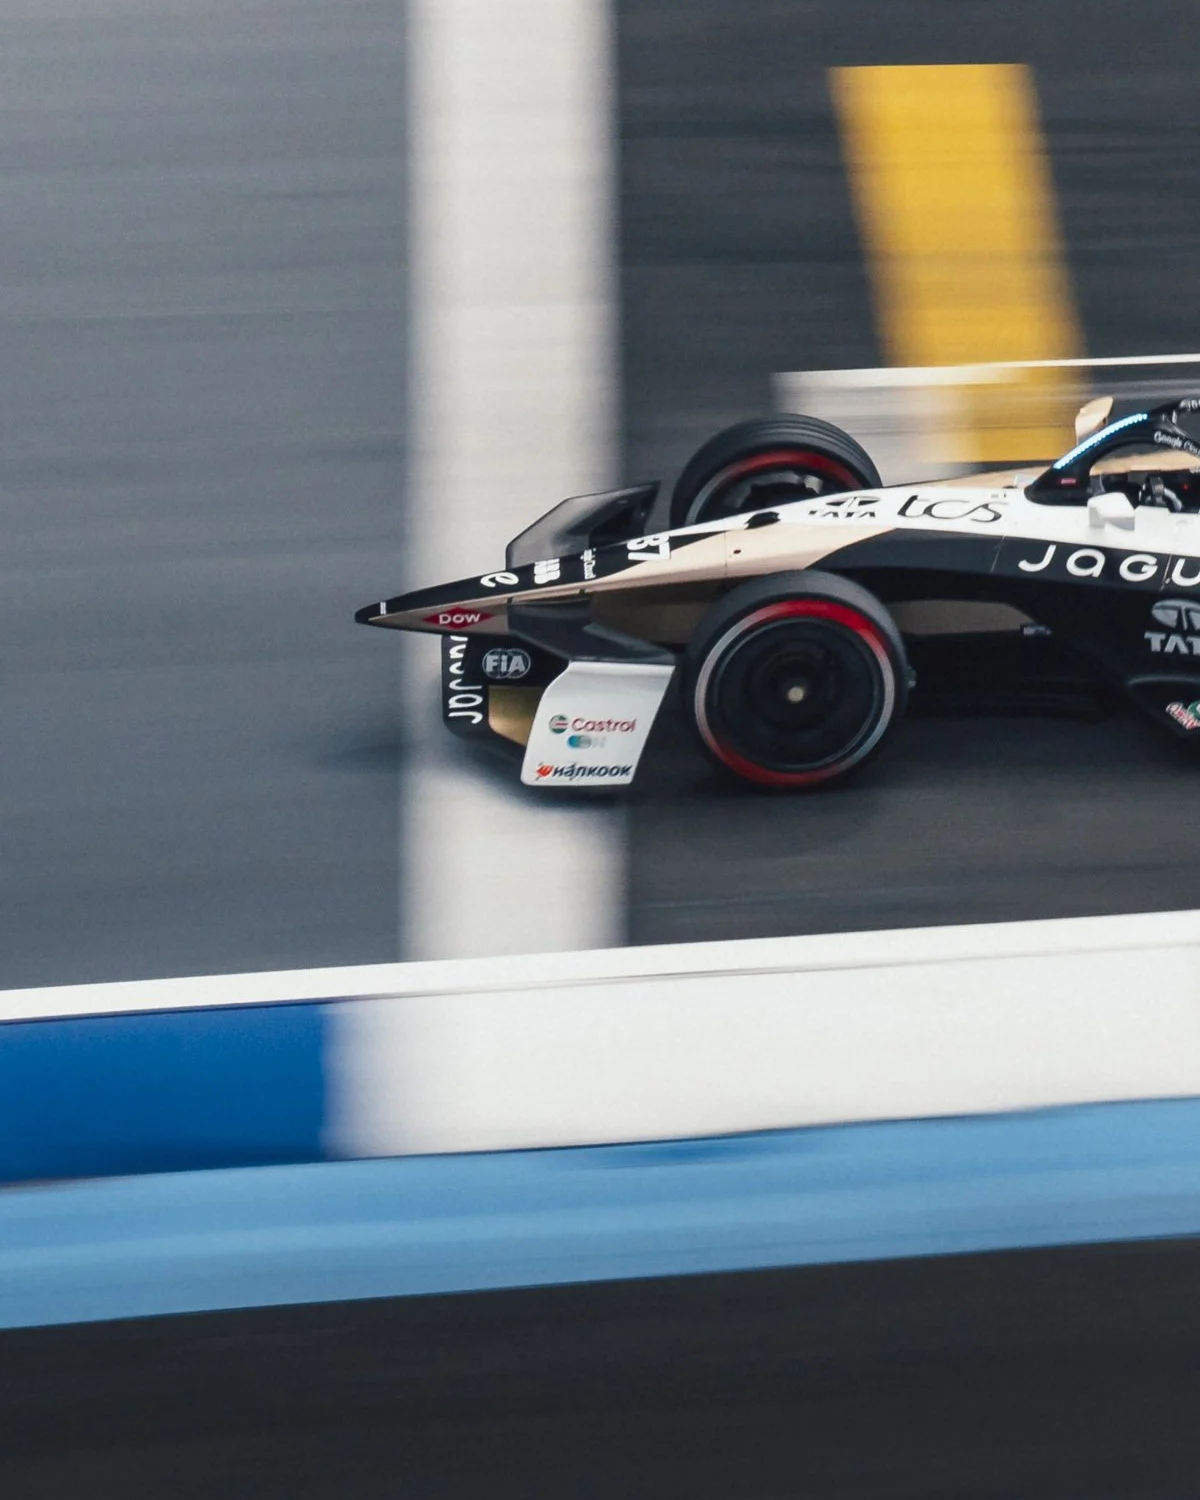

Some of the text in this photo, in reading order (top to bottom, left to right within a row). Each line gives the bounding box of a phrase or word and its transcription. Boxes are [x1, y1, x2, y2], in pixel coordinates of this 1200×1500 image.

[439, 613, 481, 624] DOW
[485, 654, 527, 674] FIA
[571, 717, 637, 732] Castrol
[553, 763, 633, 781] Hankook
